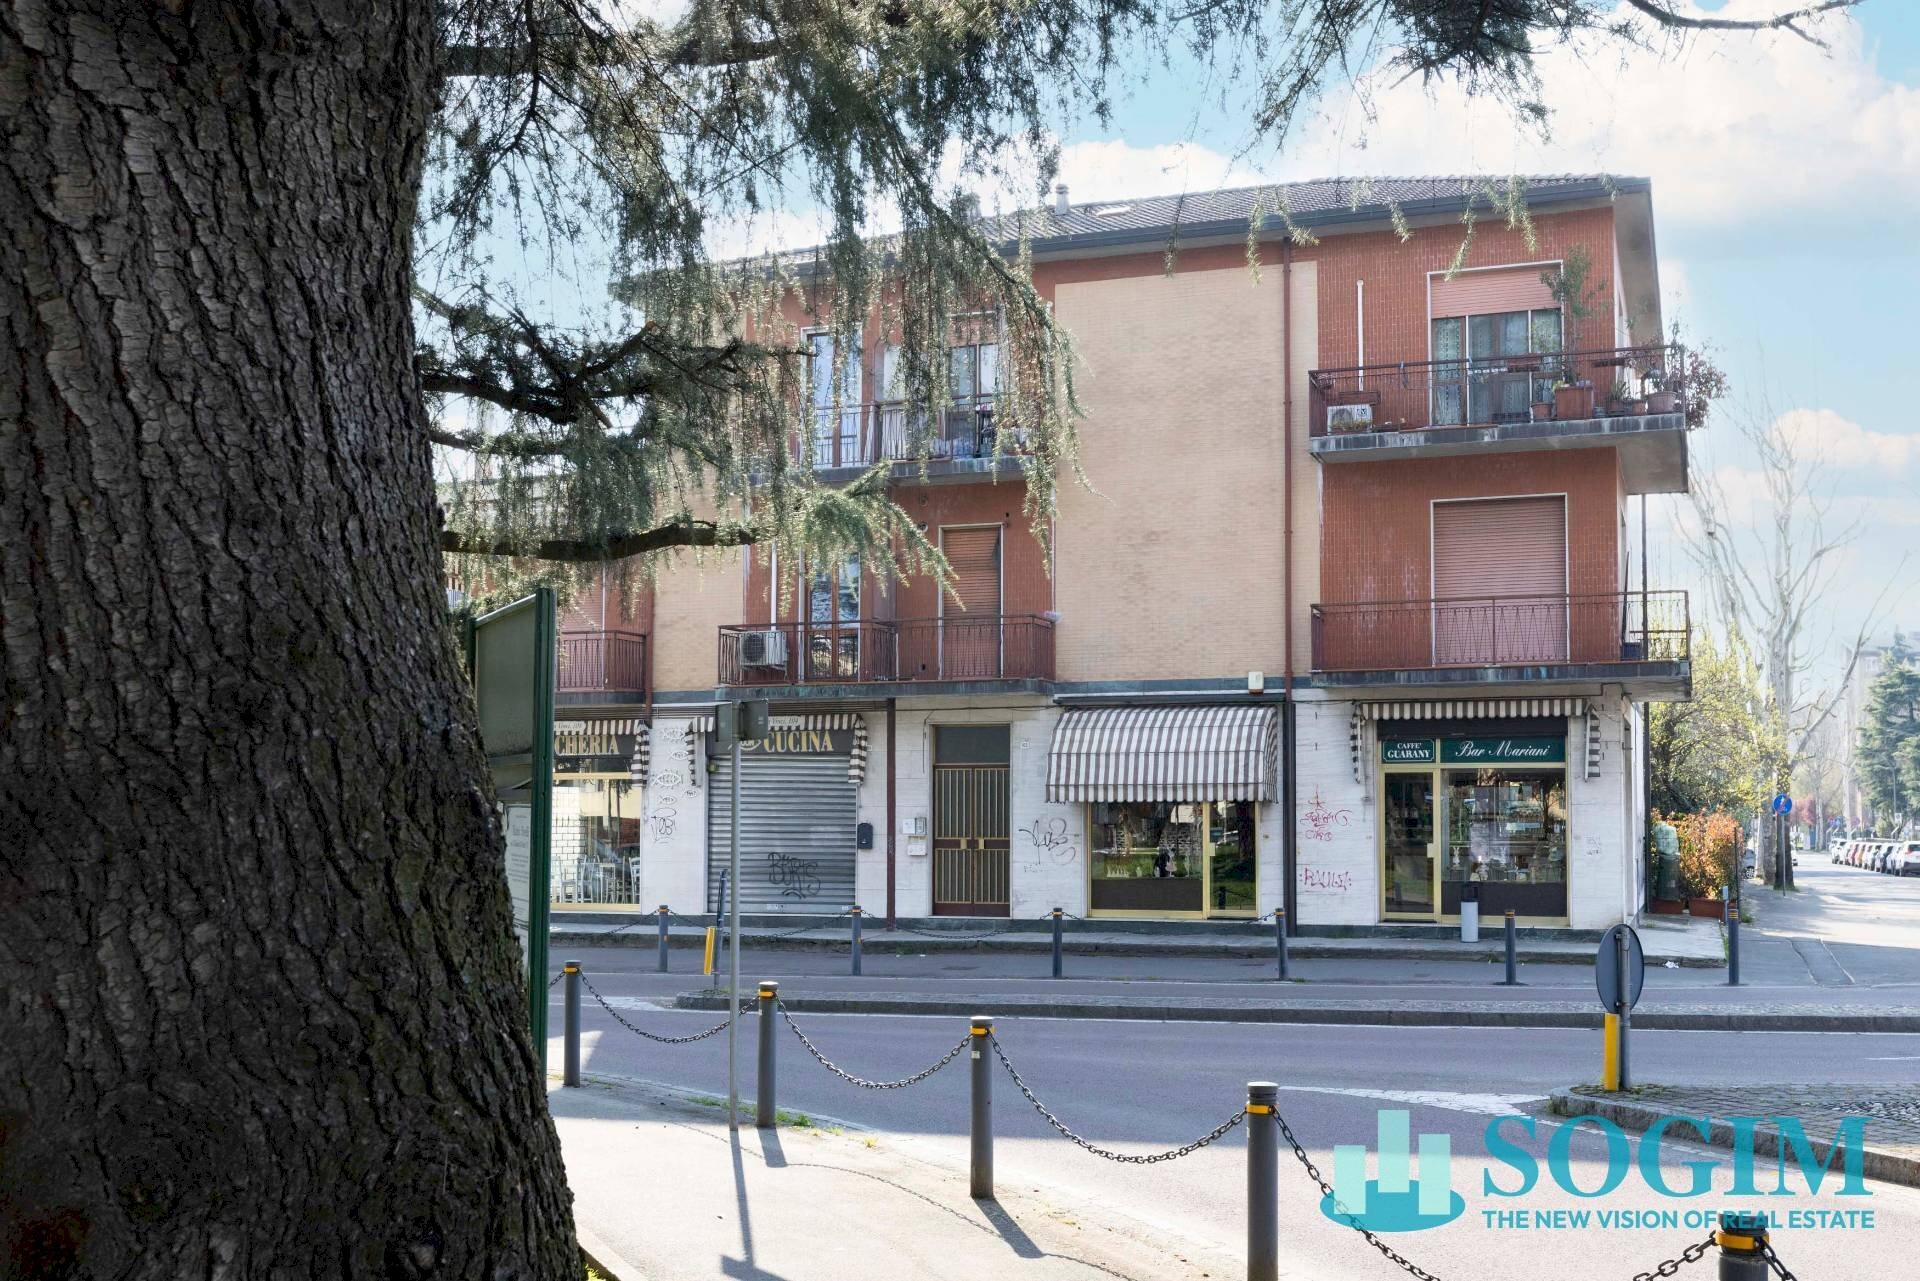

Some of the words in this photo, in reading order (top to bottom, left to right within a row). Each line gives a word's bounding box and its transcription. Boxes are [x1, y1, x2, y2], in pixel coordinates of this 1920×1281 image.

[763, 730, 834, 752] CUCINA
[1455, 740, 1485, 757] Bar
[1488, 740, 1551, 757] Mariani
[1387, 749, 1431, 759] GUARANY
